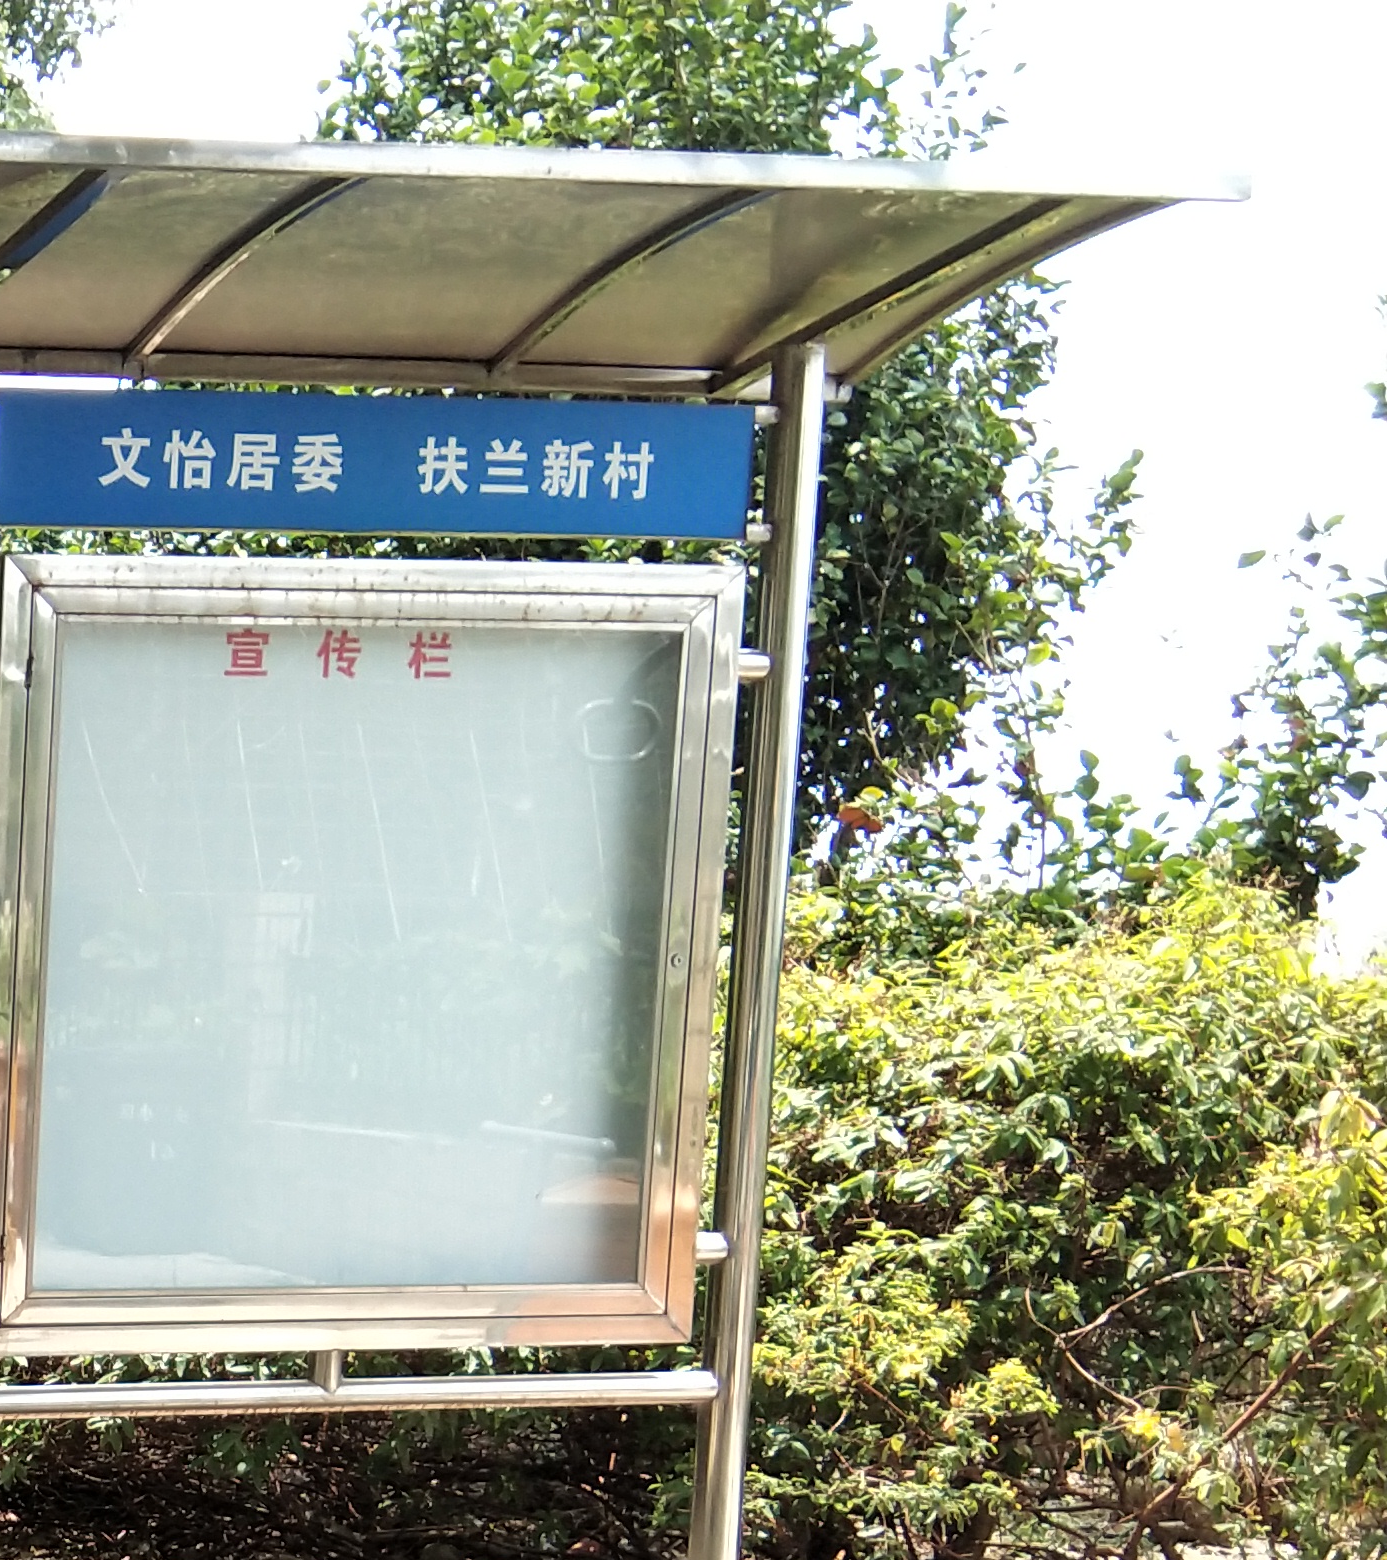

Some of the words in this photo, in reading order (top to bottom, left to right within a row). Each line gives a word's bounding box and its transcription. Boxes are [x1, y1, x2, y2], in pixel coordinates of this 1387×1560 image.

[98, 426, 345, 494] 文怡居委
[417, 435, 655, 501] 扶兰新村
[224, 628, 453, 678] 宣传栏
